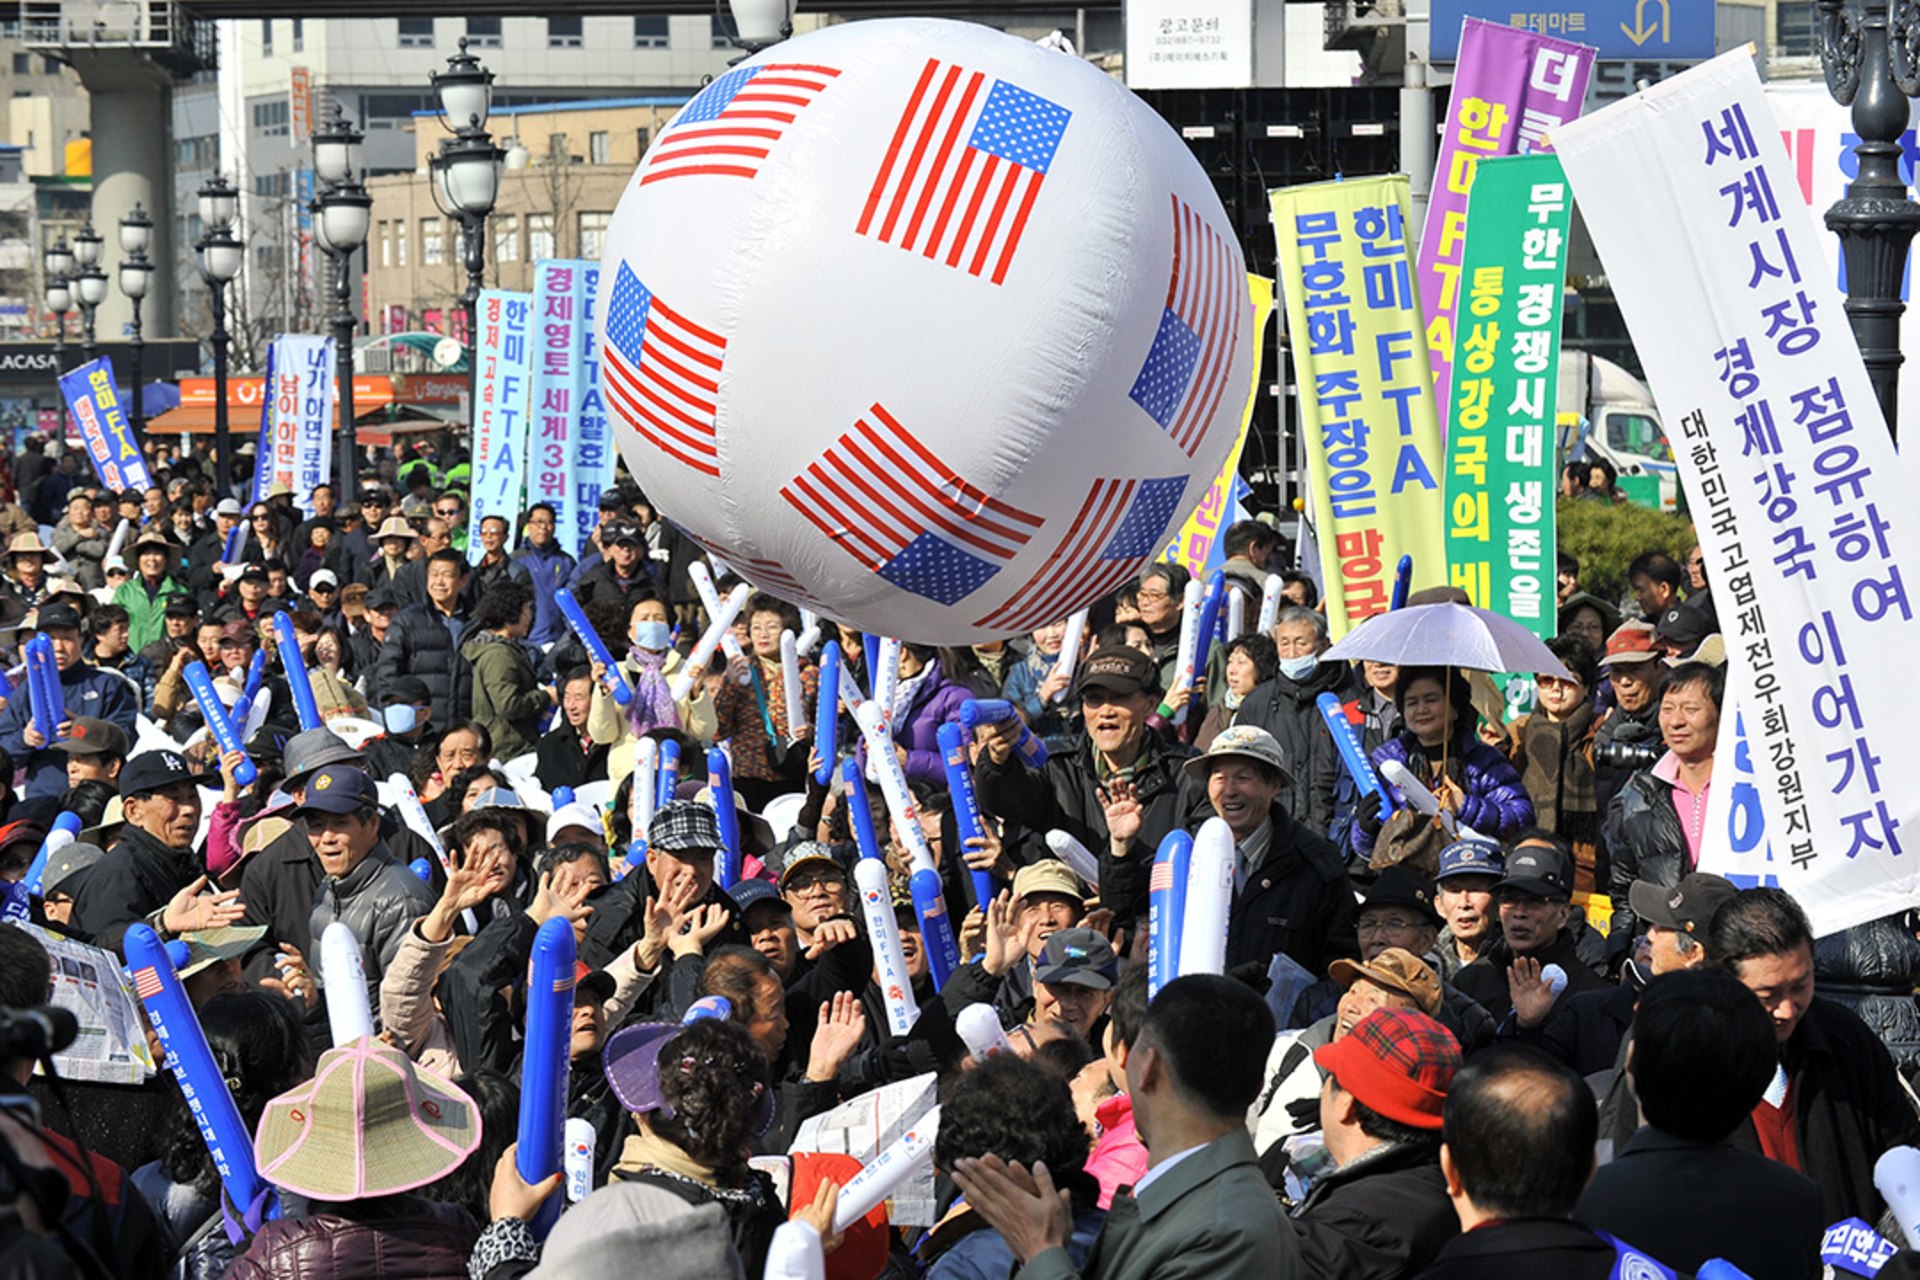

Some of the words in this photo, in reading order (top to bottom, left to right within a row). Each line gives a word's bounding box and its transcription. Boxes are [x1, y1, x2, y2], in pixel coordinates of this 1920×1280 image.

[1159, 17, 1219, 34] 광고문의
[1530, 48, 1579, 102] 더
[1353, 204, 1413, 311] 한미
[1522, 183, 1565, 270] 무한
[505, 300, 528, 366] 한미
[543, 268, 573, 376] 경제영토
[1296, 211, 1357, 356] 무효화
[278, 373, 301, 416] 남이
[307, 348, 327, 391] 내가
[1451, 266, 1505, 542] 통상강국의
[1504, 284, 1555, 467] 경쟁시대
[1701, 102, 1821, 356] 세계시장
[1790, 376, 1913, 621] 점유하여
[88, 369, 118, 411] 한미
[105, 410, 139, 461] FTA
[277, 422, 299, 465] 하면
[305, 397, 327, 441] 하면
[1315, 370, 1377, 519] 주장은
[1375, 331, 1438, 494] FTA
[1504, 481, 1543, 618] 생존을
[1714, 337, 1817, 580] 경제강국
[1799, 610, 1903, 859] 이어가자
[161, 752, 183, 771] LA
